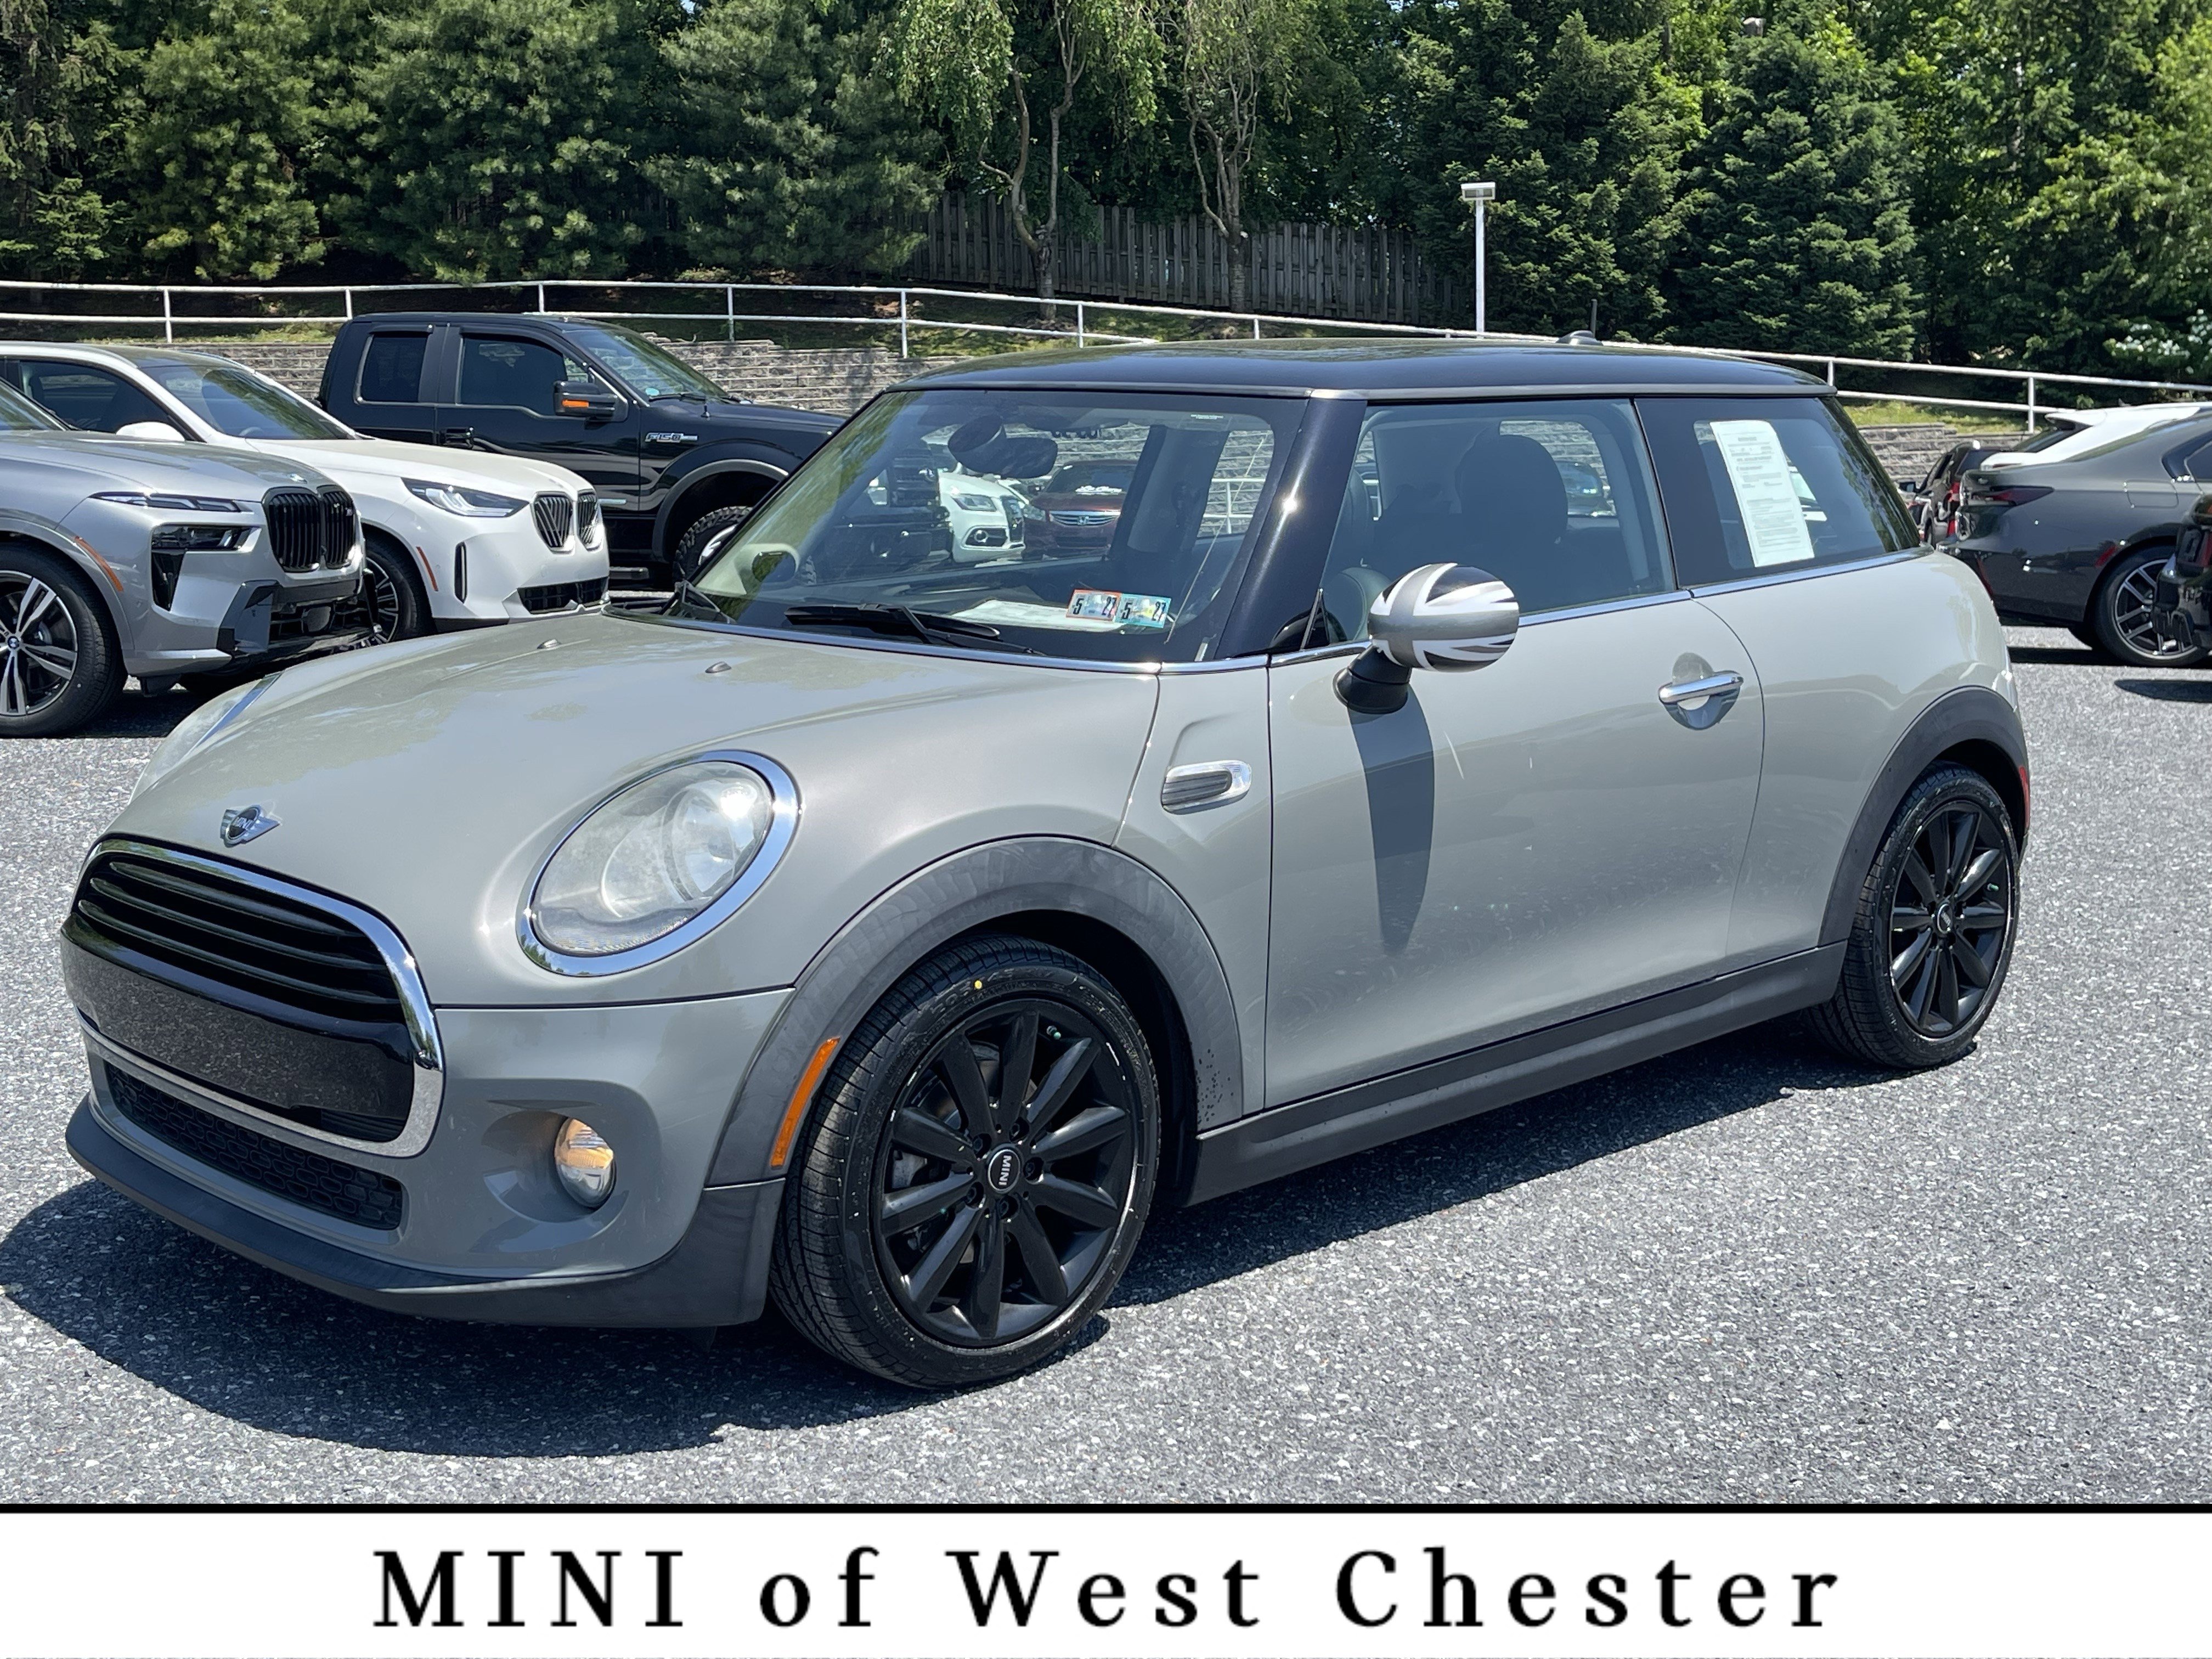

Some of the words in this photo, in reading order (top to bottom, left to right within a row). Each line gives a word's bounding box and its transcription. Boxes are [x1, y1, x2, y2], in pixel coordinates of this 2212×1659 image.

[1073, 598, 1085, 615] 5
[1121, 602, 1133, 620] 5
[998, 1155, 1012, 1186] MINI
